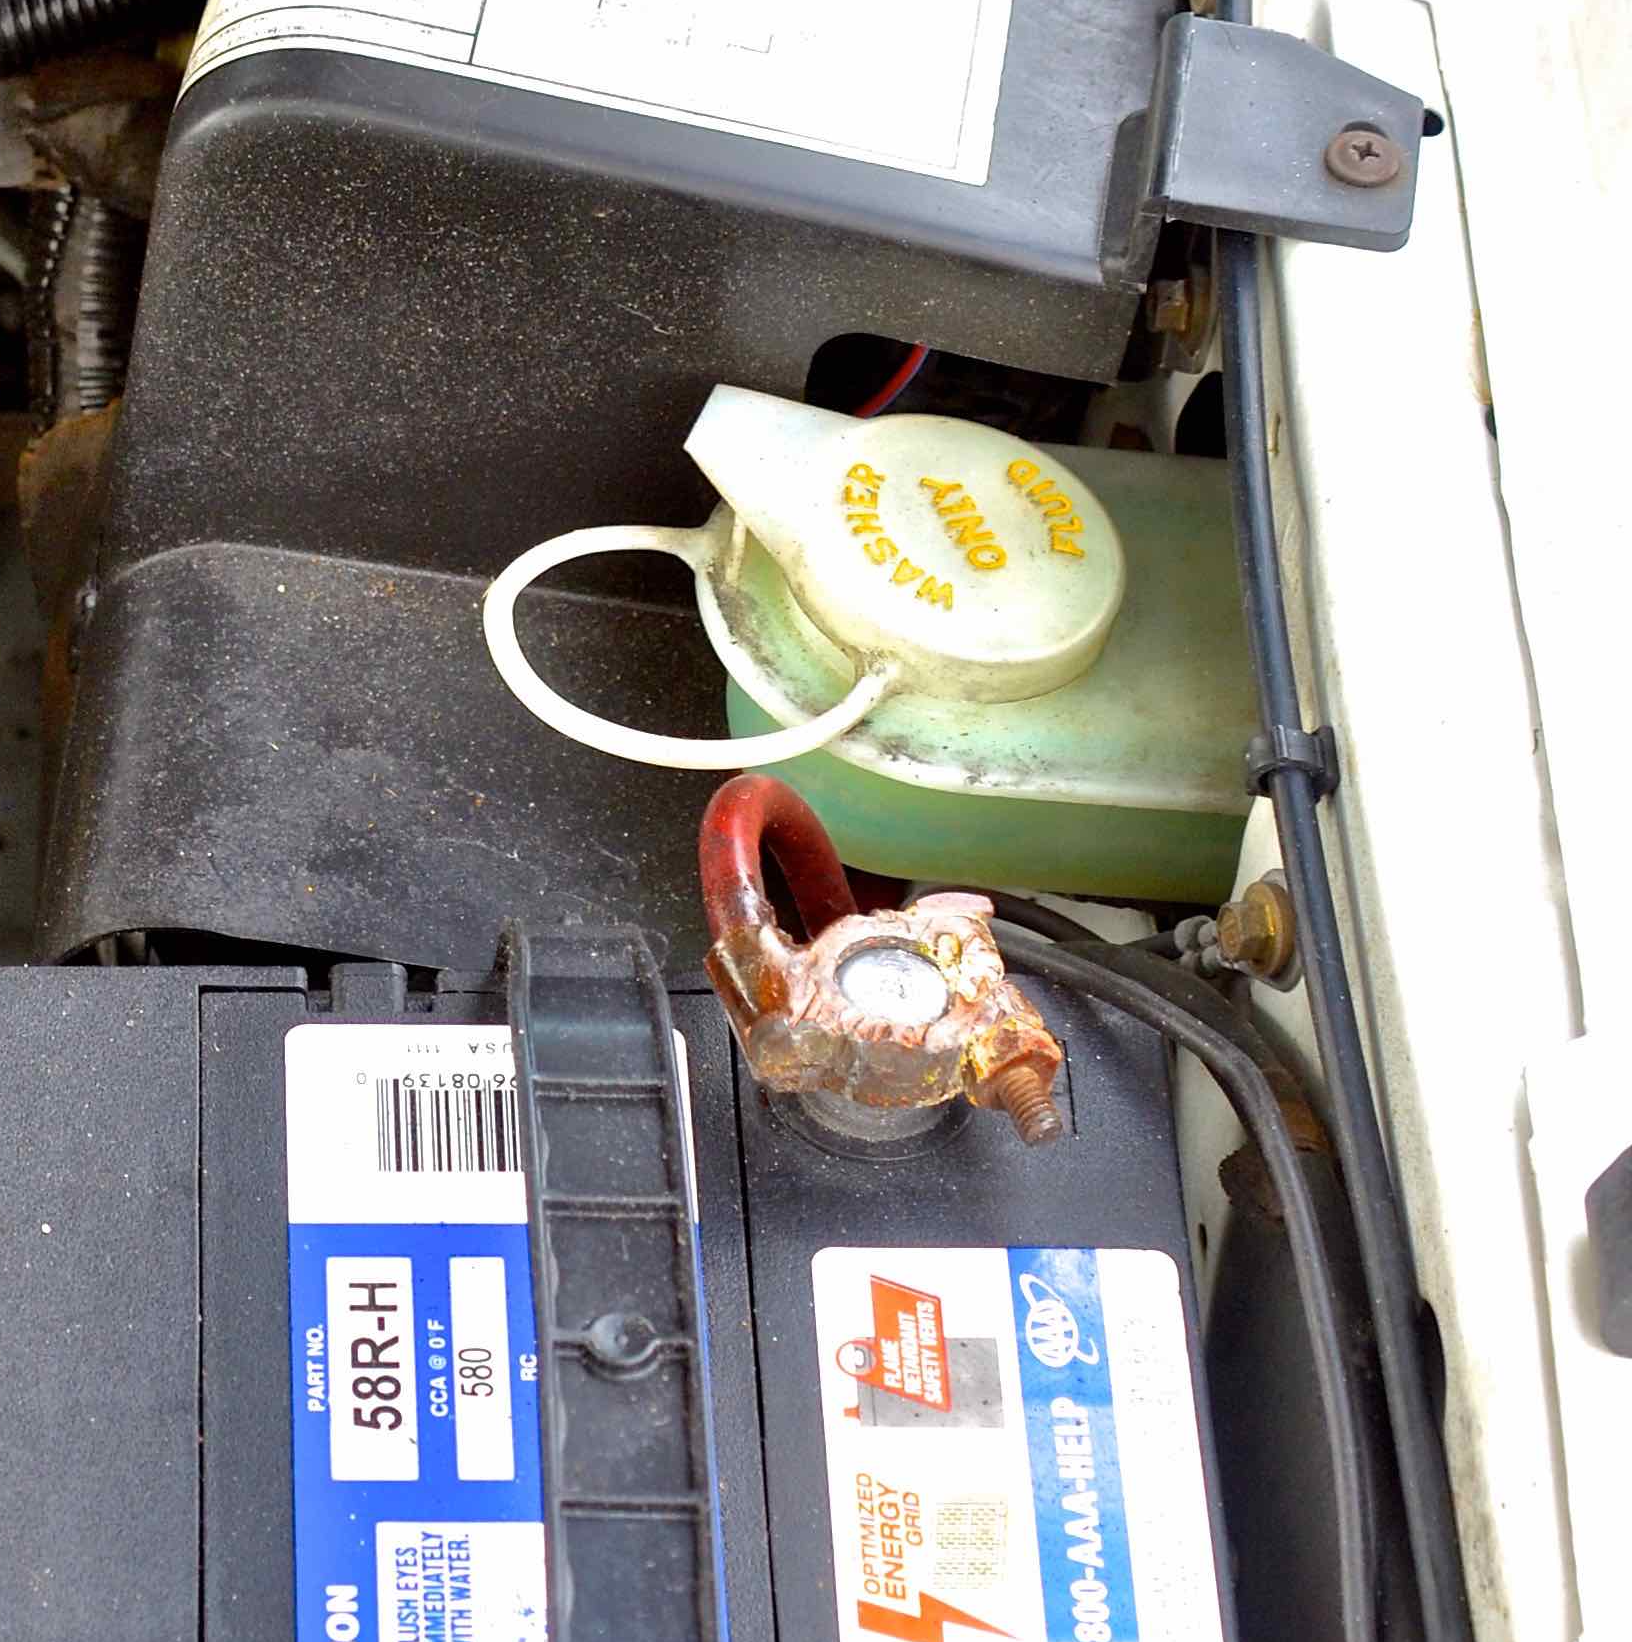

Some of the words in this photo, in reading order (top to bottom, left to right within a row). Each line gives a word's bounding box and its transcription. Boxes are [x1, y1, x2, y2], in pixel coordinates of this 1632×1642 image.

[919, 476, 1009, 571] ONLY
[1006, 458, 1087, 559] FLUID
[843, 462, 955, 613] WASHER
[306, 1324, 326, 1356] NO.
[897, 1310, 922, 1395] RETARDANT
[915, 1300, 937, 1350] VENTS
[348, 1281, 404, 1431] 58R-H
[457, 1346, 496, 1398] 580
[519, 1352, 538, 1382] RC
[881, 1338, 903, 1388] FLAME
[918, 1353, 944, 1405] SAFETY
[306, 1358, 328, 1413] PART
[430, 1375, 450, 1418] CCA
[855, 1471, 882, 1596] OPTIMIZED
[876, 1480, 907, 1602] ENERGY
[903, 1489, 924, 1547] GRID
[395, 1544, 419, 1592] EYES
[448, 1532, 473, 1608] WATER.
